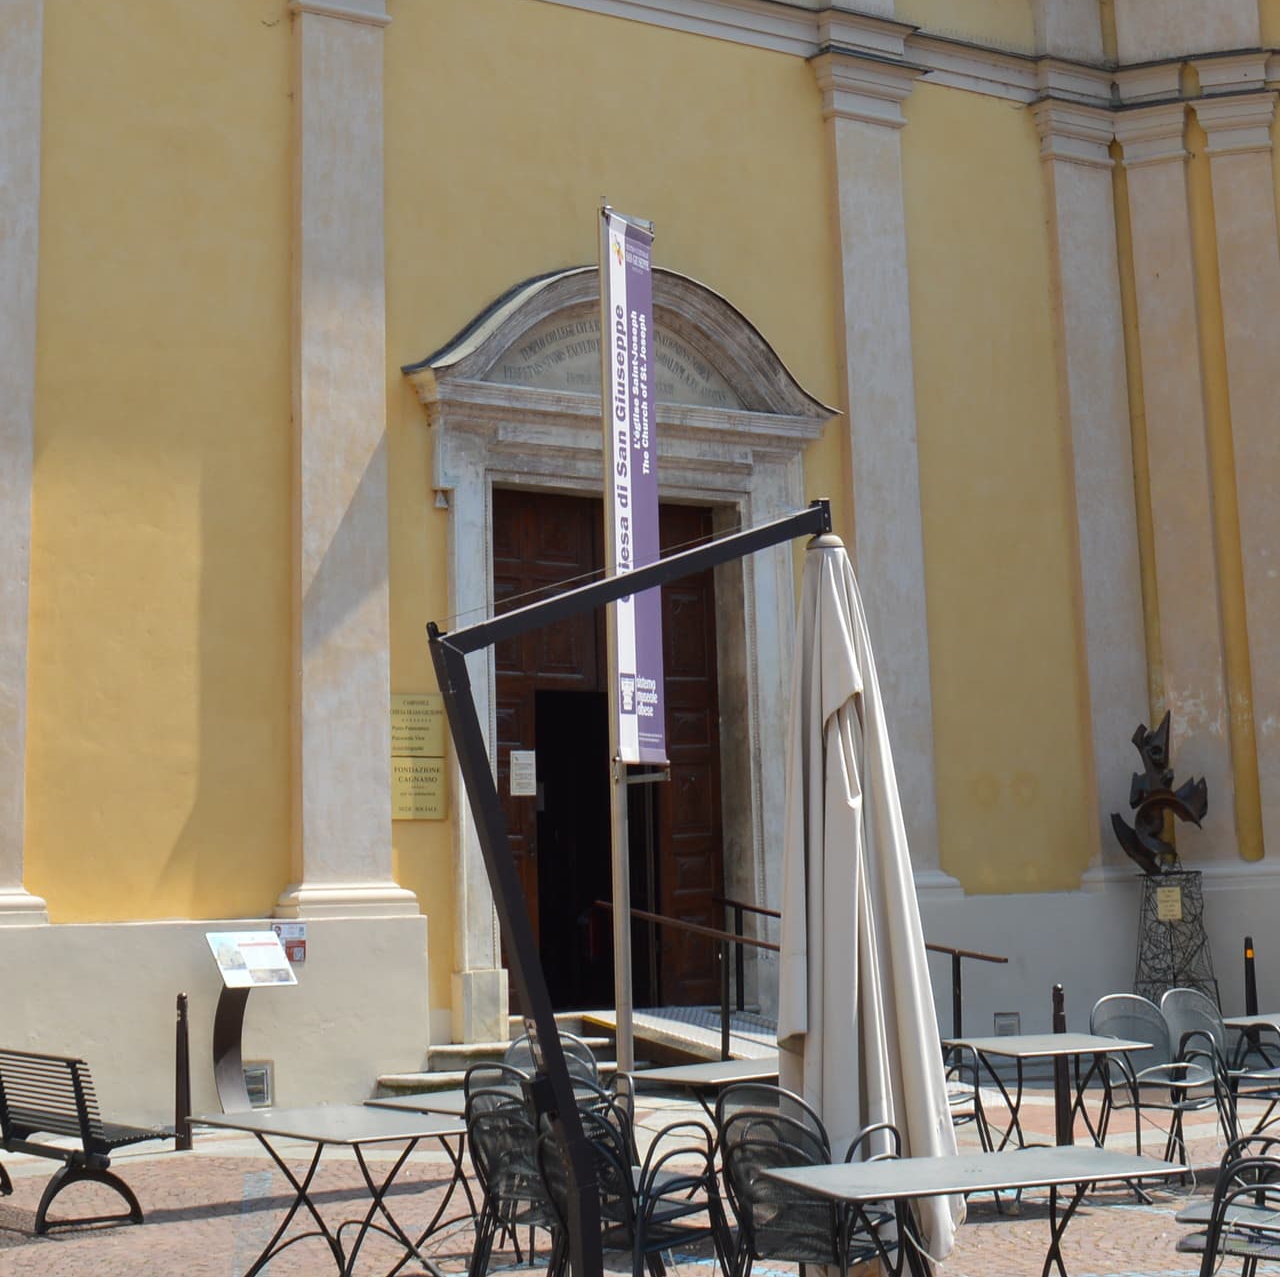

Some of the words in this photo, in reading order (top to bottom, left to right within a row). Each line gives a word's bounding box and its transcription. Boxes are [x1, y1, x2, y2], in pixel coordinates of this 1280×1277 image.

[631, 311, 640, 396] Saint-Joseph
[639, 314, 647, 360] Joseph
[615, 305, 627, 422] Giuseppe
[640, 363, 648, 383] St.
[641, 384, 649, 399] of
[641, 400, 650, 447] Church
[616, 430, 628, 478] San
[642, 451, 651, 475] The
[617, 485, 628, 508] di
